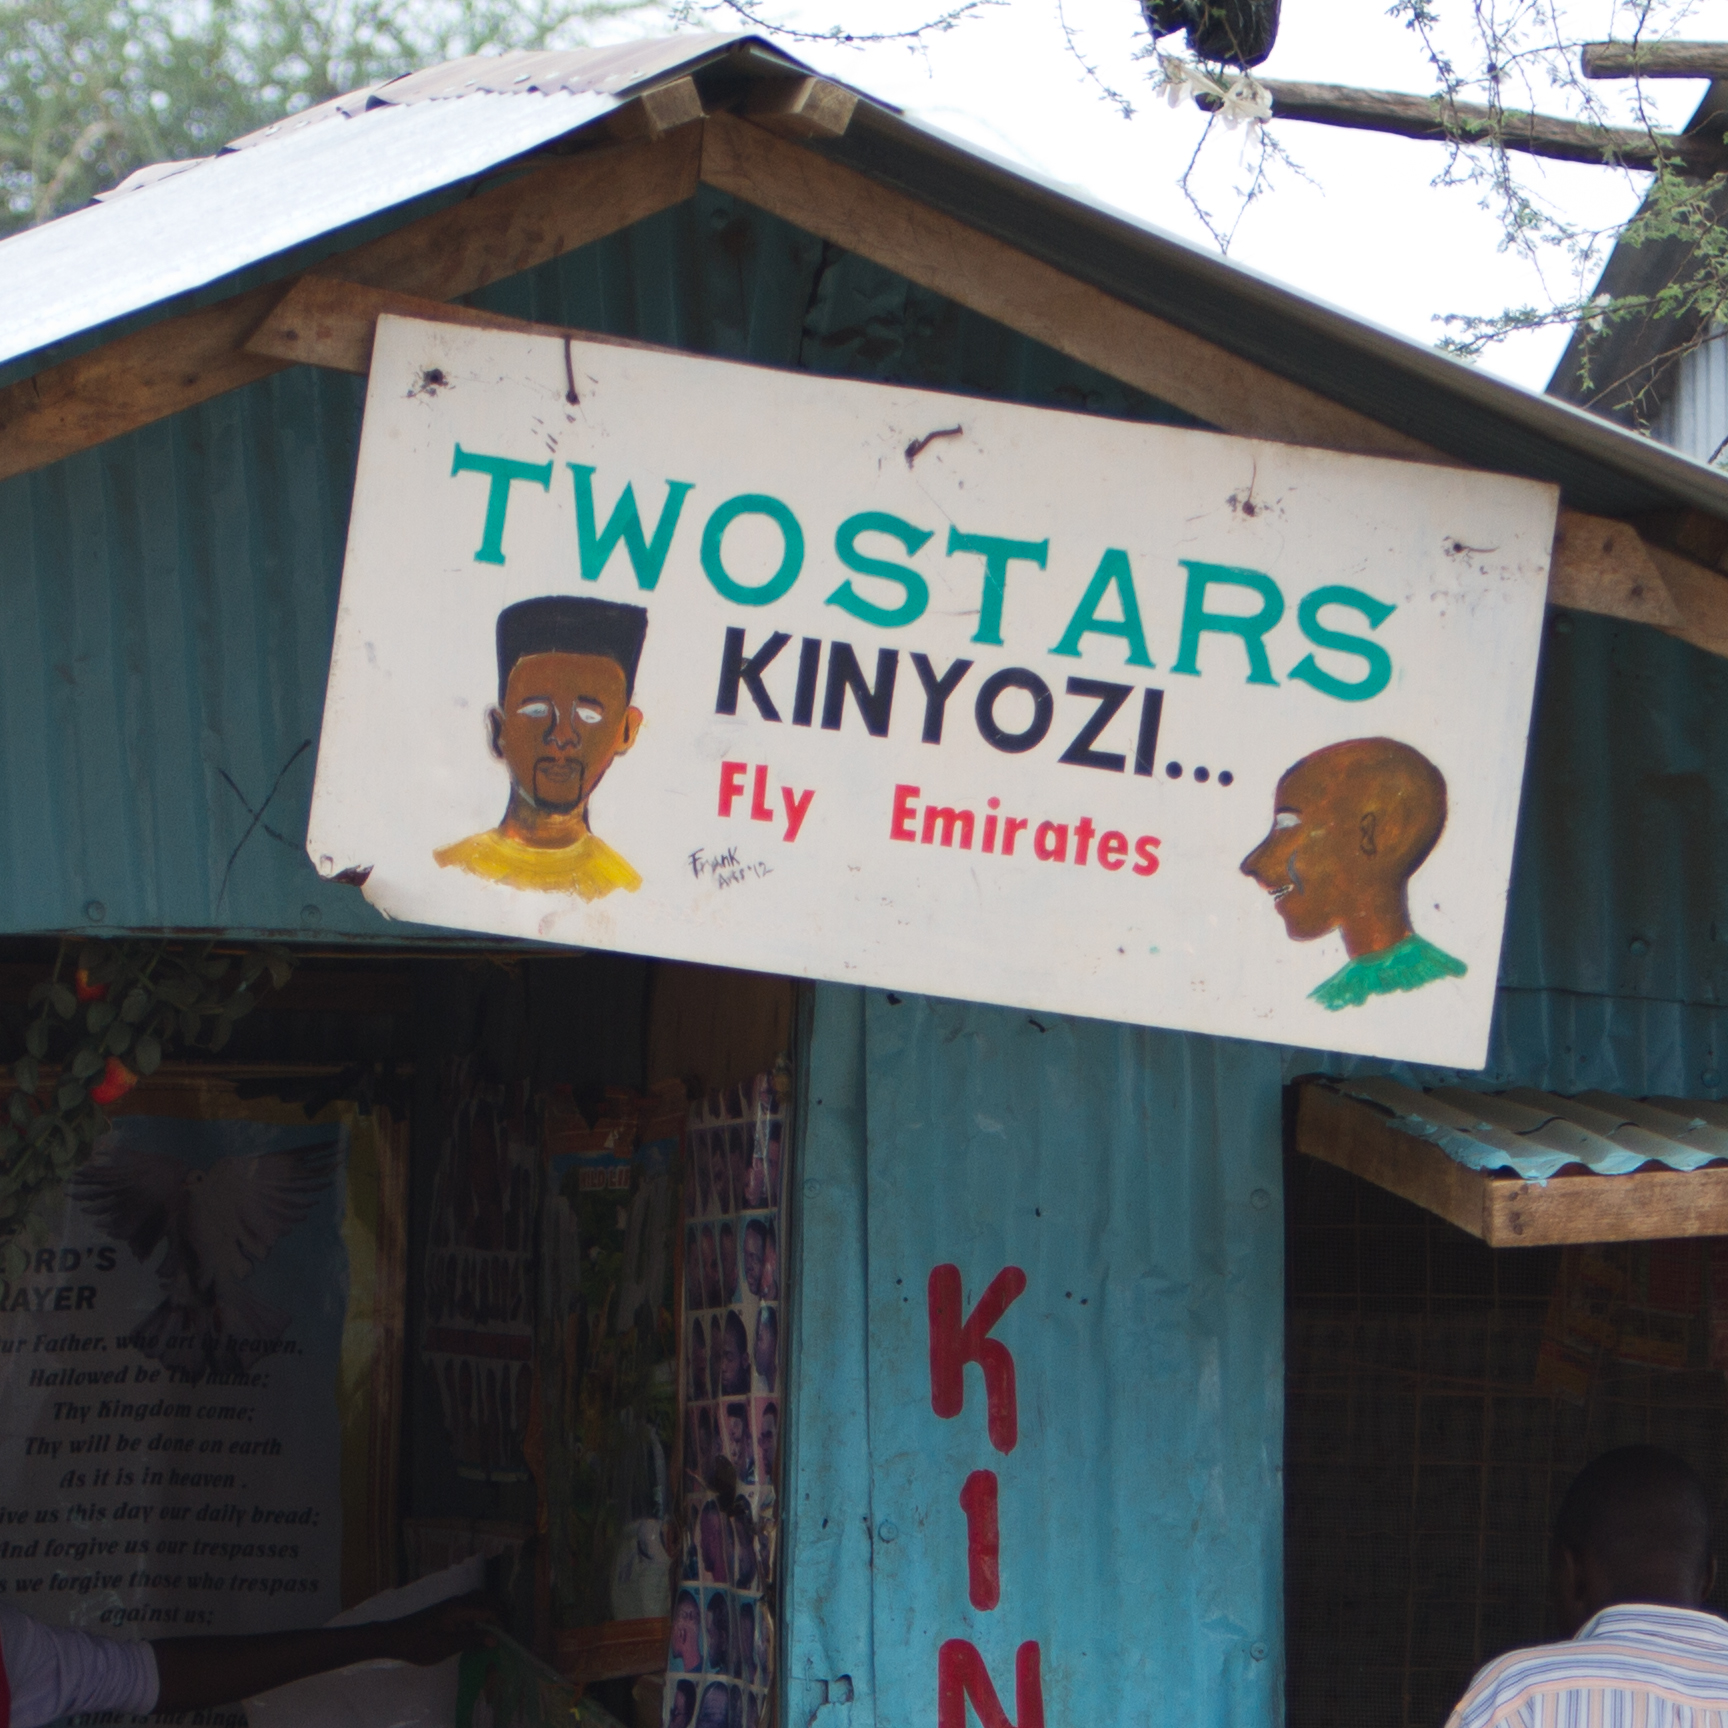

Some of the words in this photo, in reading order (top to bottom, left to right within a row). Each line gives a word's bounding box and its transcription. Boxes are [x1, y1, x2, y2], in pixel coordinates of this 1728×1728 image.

[889, 784, 1163, 878] Emirates
[116, 1334, 158, 1349] who
[166, 1333, 194, 1350] art
[29, 1365, 127, 1387] Hallowed
[135, 1365, 160, 1384] be
[53, 1401, 90, 1424] Thy
[97, 1399, 191, 1422] Kingdom
[25, 1436, 62, 1459] Thy
[70, 1434, 109, 1454] will
[116, 1434, 142, 1452] be
[148, 1433, 195, 1453] done
[199, 1439, 223, 1453] on
[229, 1437, 283, 1455] earth
[59, 1469, 86, 1488] As
[93, 1468, 110, 1486] it
[116, 1468, 134, 1486] is
[142, 1466, 163, 1486] in
[169, 1467, 235, 1488] heaven
[35, 1508, 59, 1524] us
[66, 1503, 106, 1523] this
[112, 1502, 153, 1523] day
[159, 1507, 191, 1521] our
[196, 1503, 246, 1527] daily
[44, 1537, 119, 1561] forgive
[124, 1538, 149, 1555] us
[156, 1541, 188, 1556] our
[192, 1537, 299, 1561] trespasses
[15, 1577, 43, 1593] we
[48, 1571, 122, 1594] forgive
[128, 1571, 182, 1589] those
[187, 1572, 224, 1591] who
[229, 1574, 319, 1596] trespass
[100, 1604, 180, 1626] against
